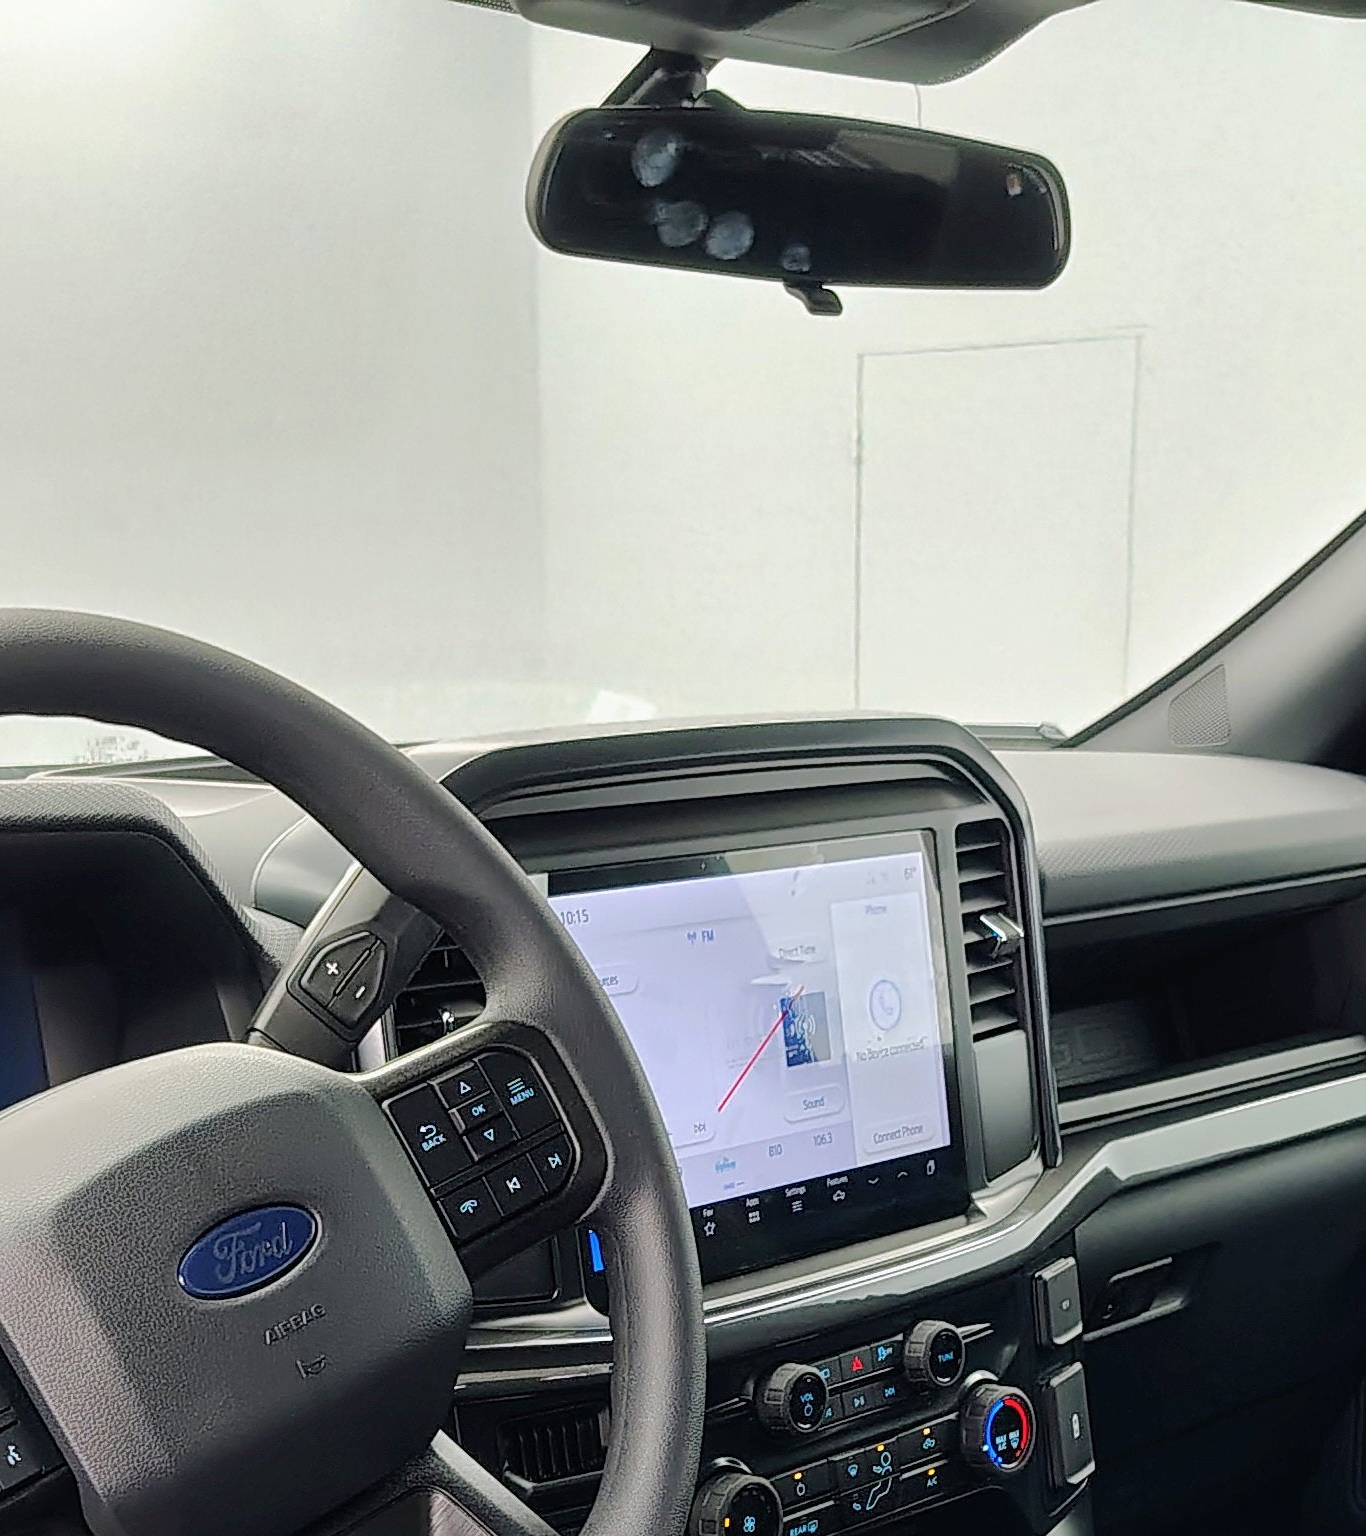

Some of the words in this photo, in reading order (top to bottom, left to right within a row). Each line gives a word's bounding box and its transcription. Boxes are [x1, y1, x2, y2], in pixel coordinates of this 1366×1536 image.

[701, 929, 715, 943] FM
[510, 1088, 534, 1106] MENU
[803, 1096, 825, 1111] Sound
[471, 1104, 486, 1116] OK
[421, 1133, 447, 1151] BACK
[813, 1133, 833, 1146] 106.3
[873, 1129, 901, 1145] Connect
[901, 1123, 924, 1139] Phone
[213, 1221, 293, 1284] Ford
